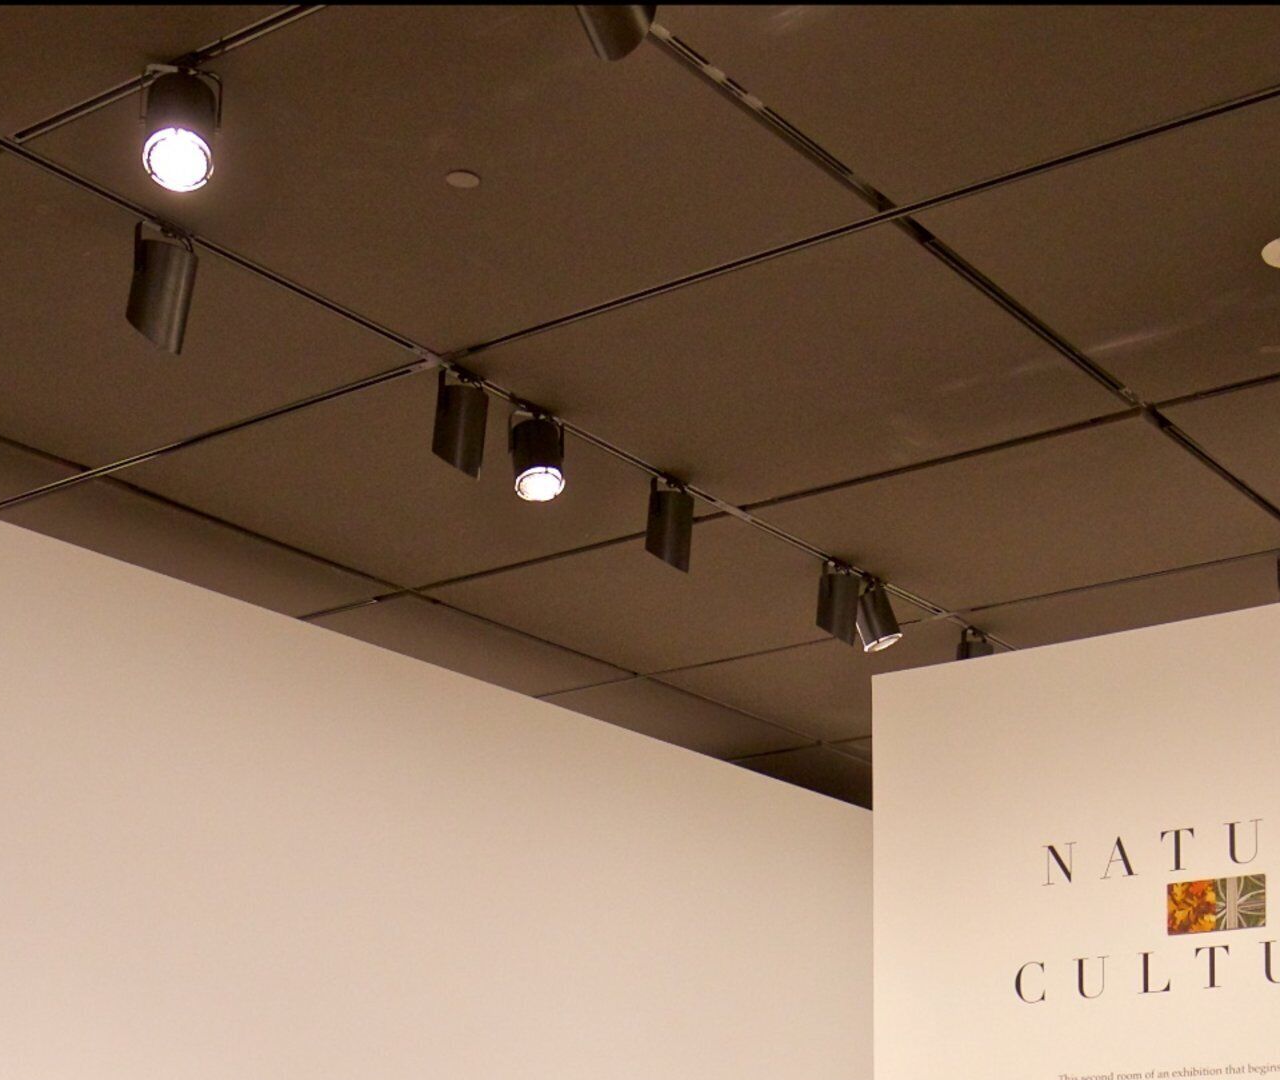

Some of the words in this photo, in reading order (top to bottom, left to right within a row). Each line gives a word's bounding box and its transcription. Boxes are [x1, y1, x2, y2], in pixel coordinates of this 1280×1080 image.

[1145, 1070, 1155, 1079] of
[1172, 1067, 1222, 1077] exhibition
[1225, 1064, 1245, 1074] that
